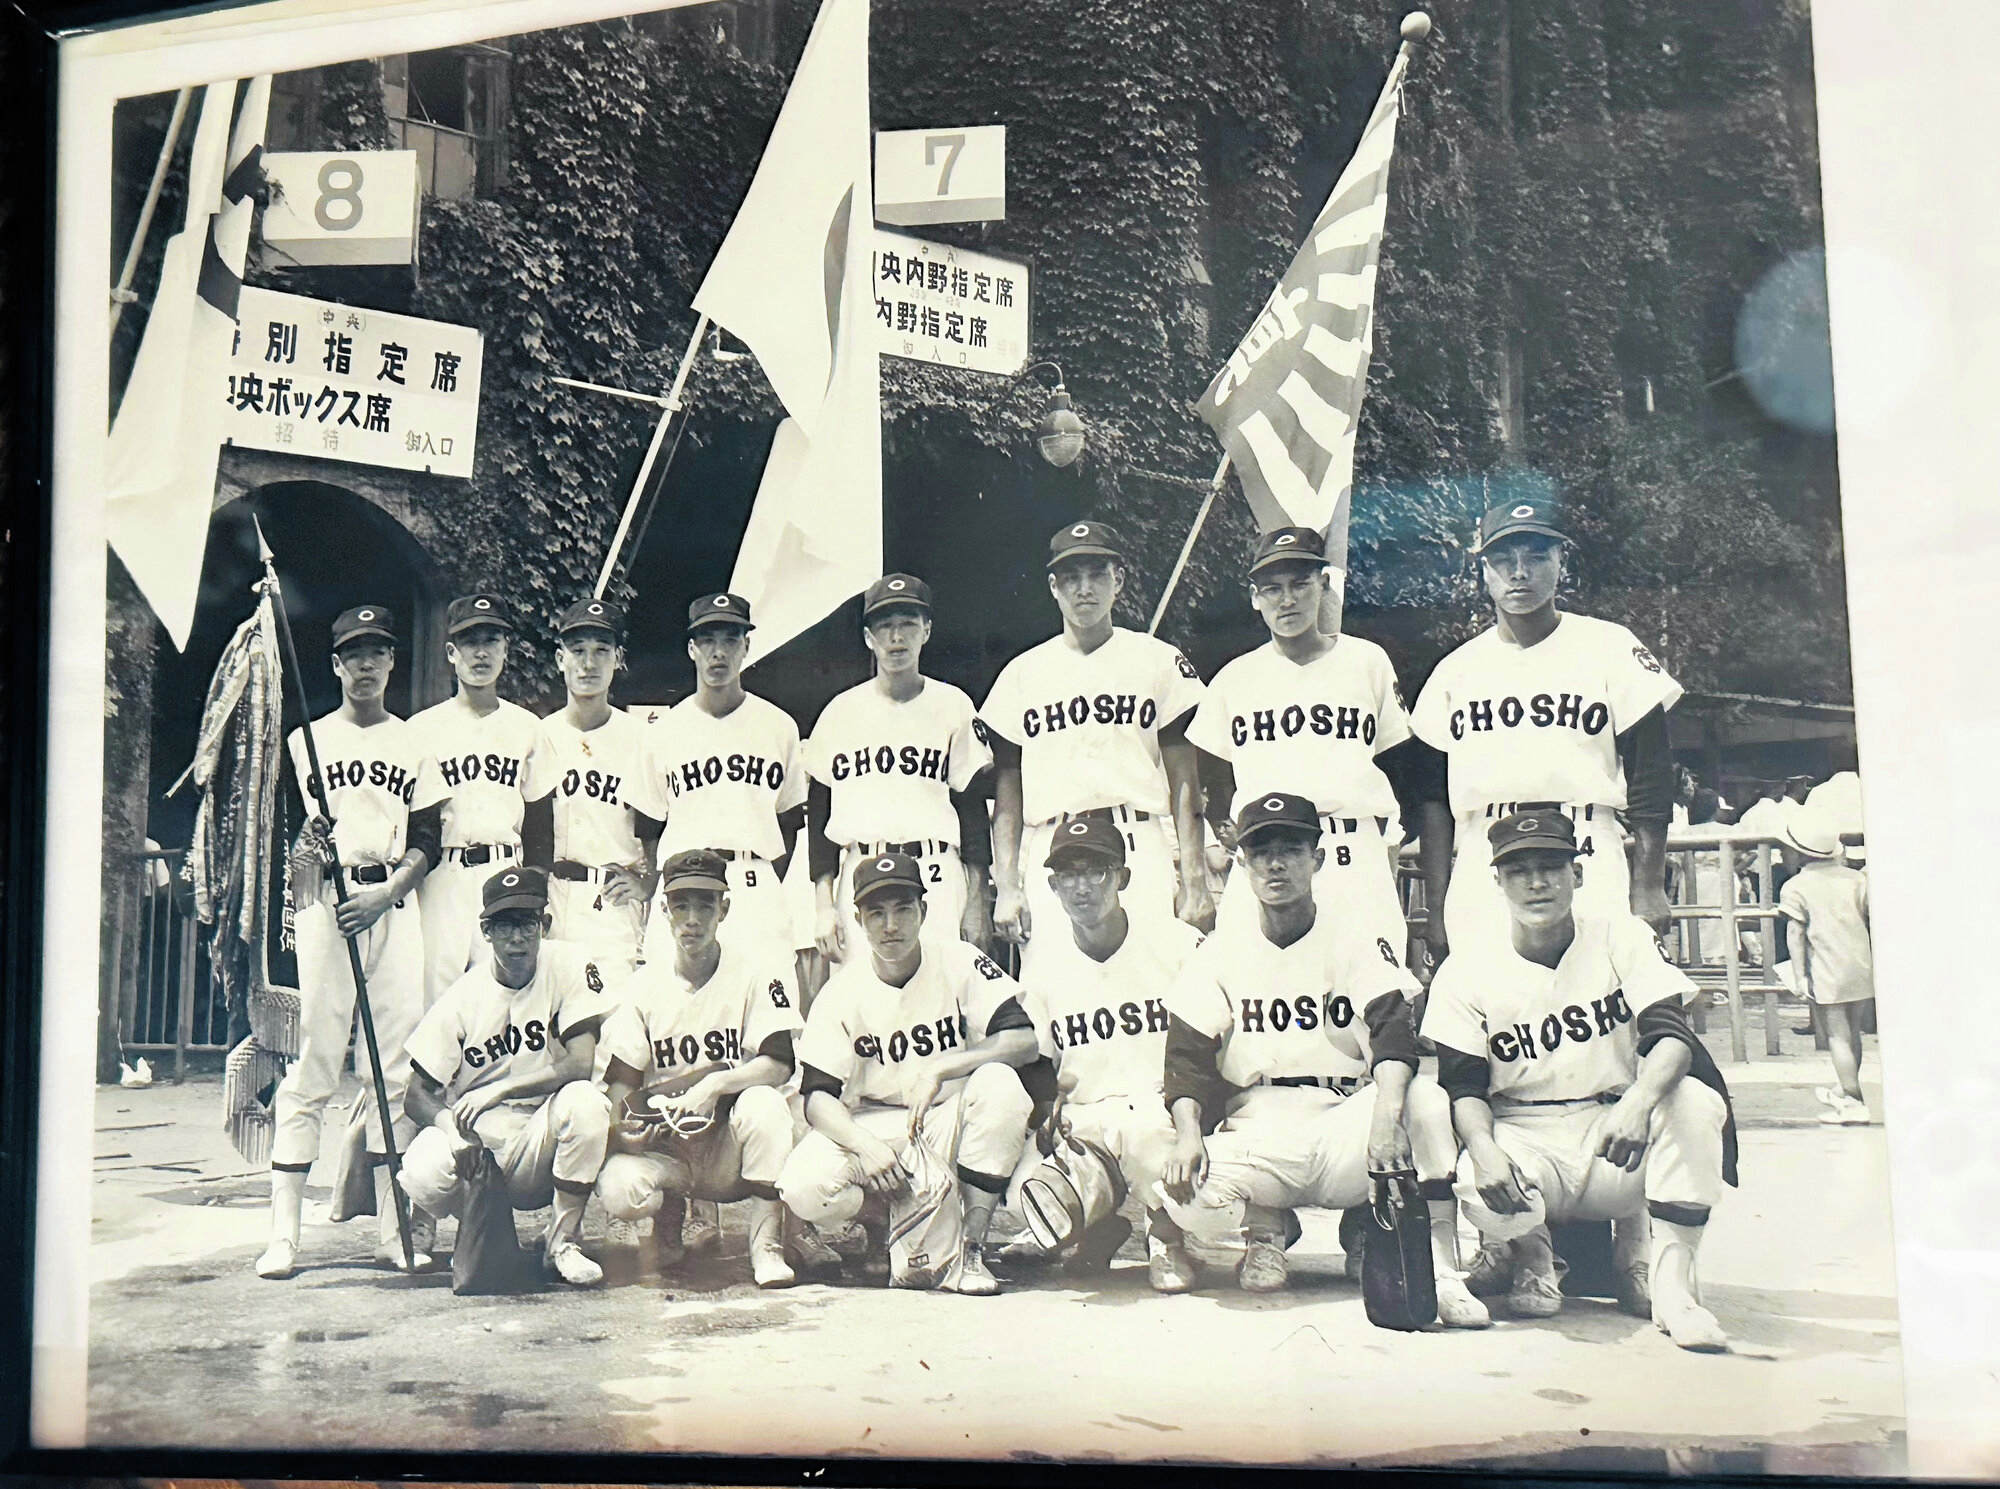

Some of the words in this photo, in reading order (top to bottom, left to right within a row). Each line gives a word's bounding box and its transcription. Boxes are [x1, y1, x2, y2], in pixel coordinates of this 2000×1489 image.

[925, 134, 965, 196] 7
[315, 159, 364, 231] 8
[1024, 694, 1157, 738] CHOSHO
[1231, 703, 1376, 747] CHOSHO
[1450, 693, 1609, 741] CHOSHO
[929, 864, 942, 882] 2
[1336, 845, 1351, 866] 8
[745, 871, 757, 887] 9
[1490, 988, 1633, 1063] CHOSHO
